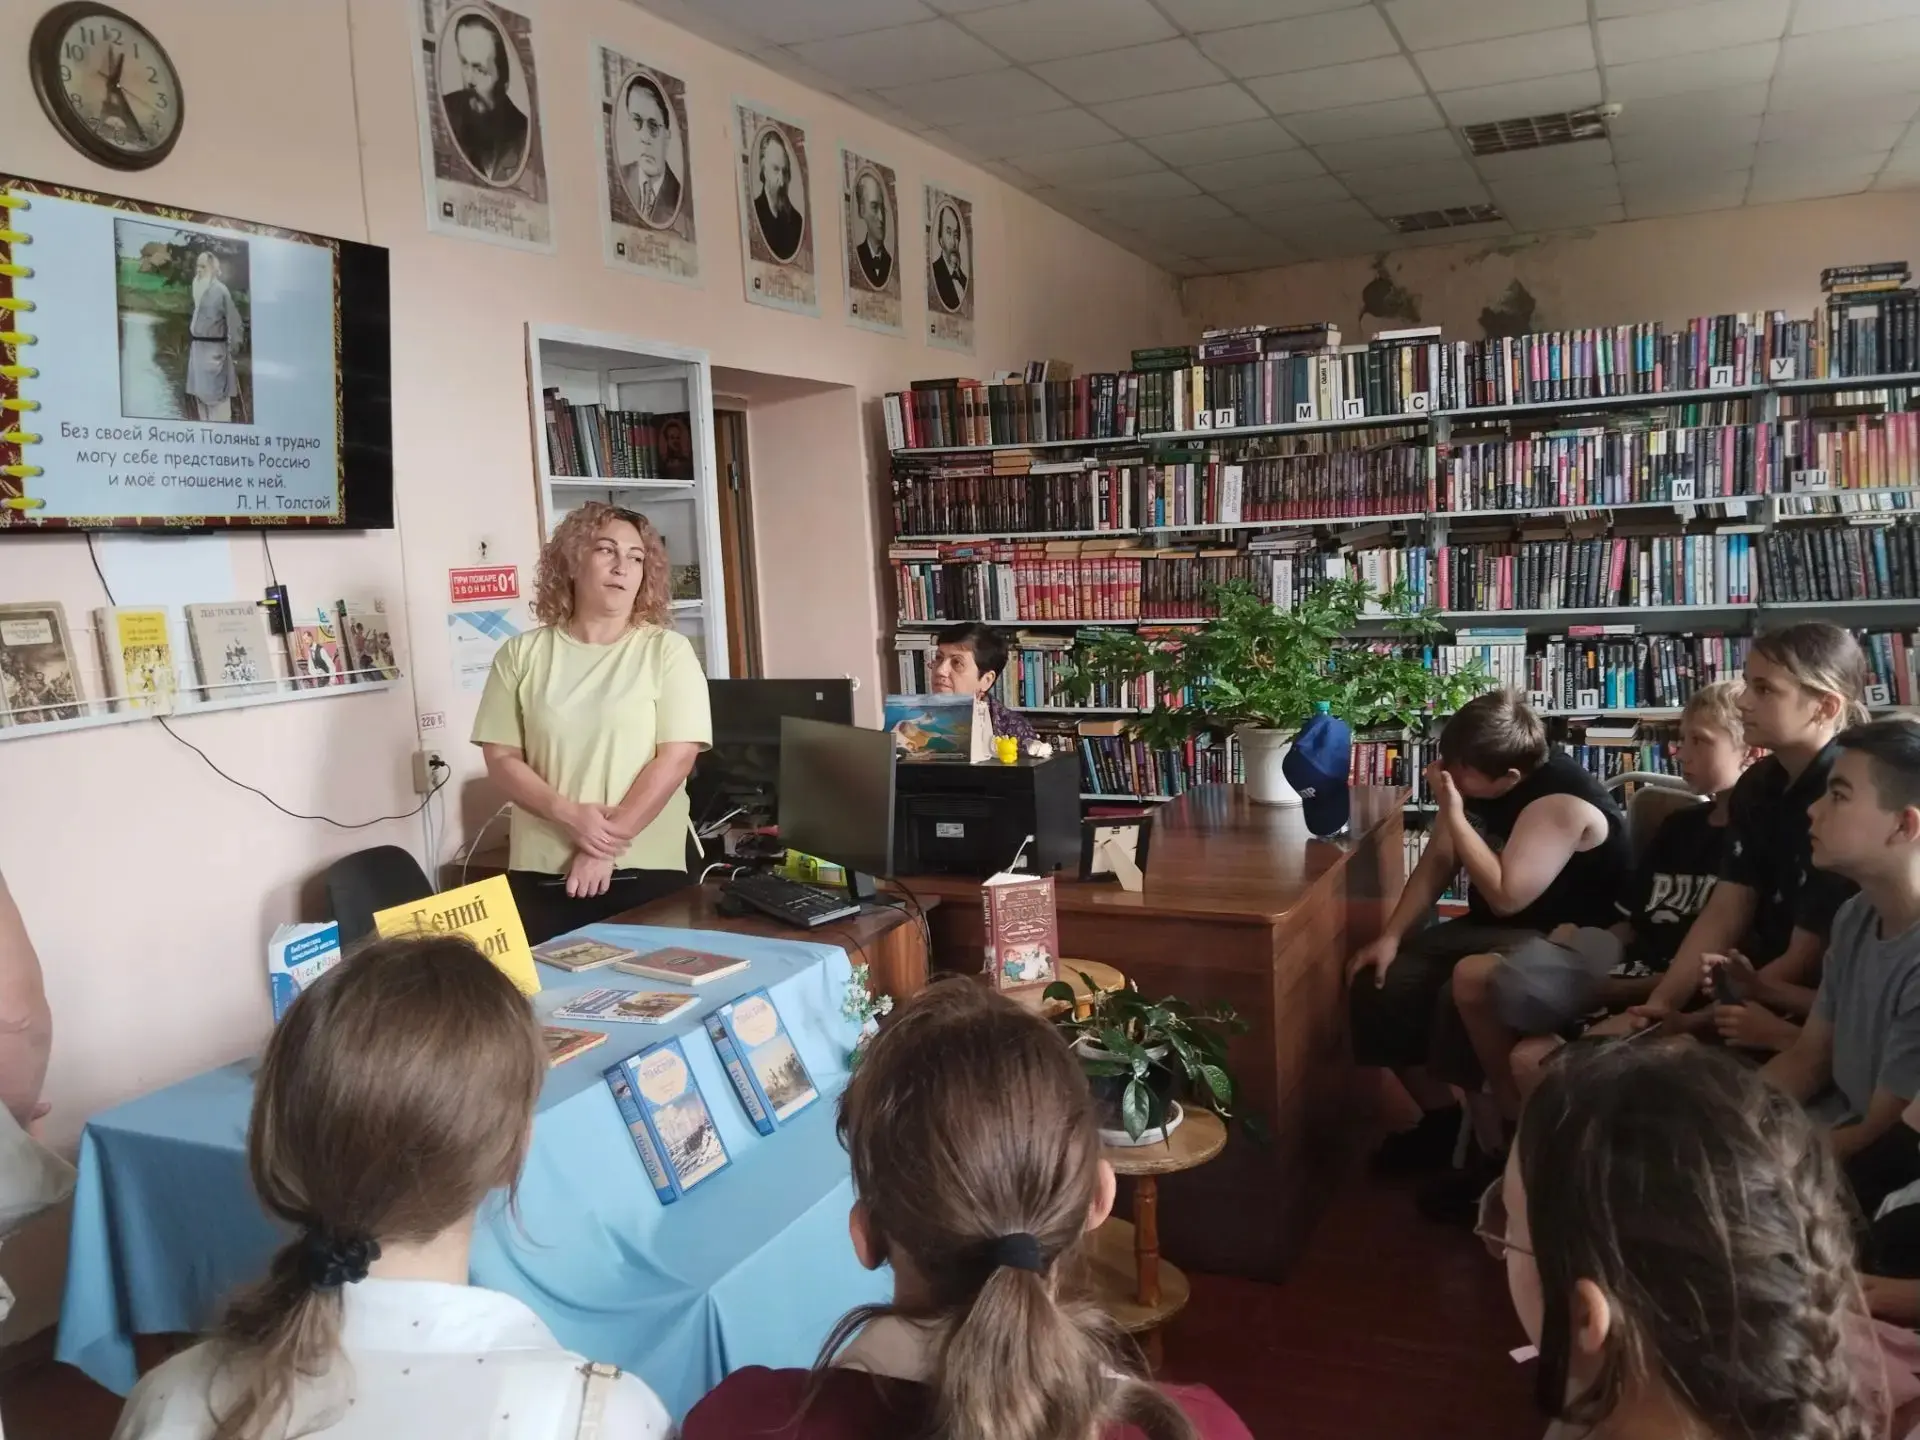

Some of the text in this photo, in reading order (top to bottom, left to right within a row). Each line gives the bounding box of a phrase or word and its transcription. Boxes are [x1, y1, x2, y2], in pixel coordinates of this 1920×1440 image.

[80, 26, 95, 45] 11
[65, 42, 84, 61] 10
[133, 43, 139, 59] 1
[145, 66, 158, 83] 2
[155, 92, 168, 109] 3
[1776, 359, 1788, 374] У
[1714, 369, 1728, 384] Л
[1348, 402, 1359, 414] П
[1413, 396, 1425, 409] С
[1220, 412, 1231, 424] Л
[1299, 406, 1312, 418] М
[1199, 414, 1209, 426] К
[61, 421, 321, 452] Без своей Ясной Поляны я трудно
[76, 449, 311, 469] могу себе представить Россию
[108, 472, 287, 489] и моё отношение к ней.
[1794, 472, 1807, 486] Ч
[1676, 483, 1691, 497] М
[237, 495, 331, 510] Л. Н. Толстой
[453, 574, 497, 585] ПРИ ПОЖАРЕ
[498, 572, 516, 592] 01
[454, 584, 498, 594] ЗВОНИТЬ
[1532, 693, 1544, 707] Н
[1581, 693, 1593, 706] П
[1871, 687, 1885, 702] Б
